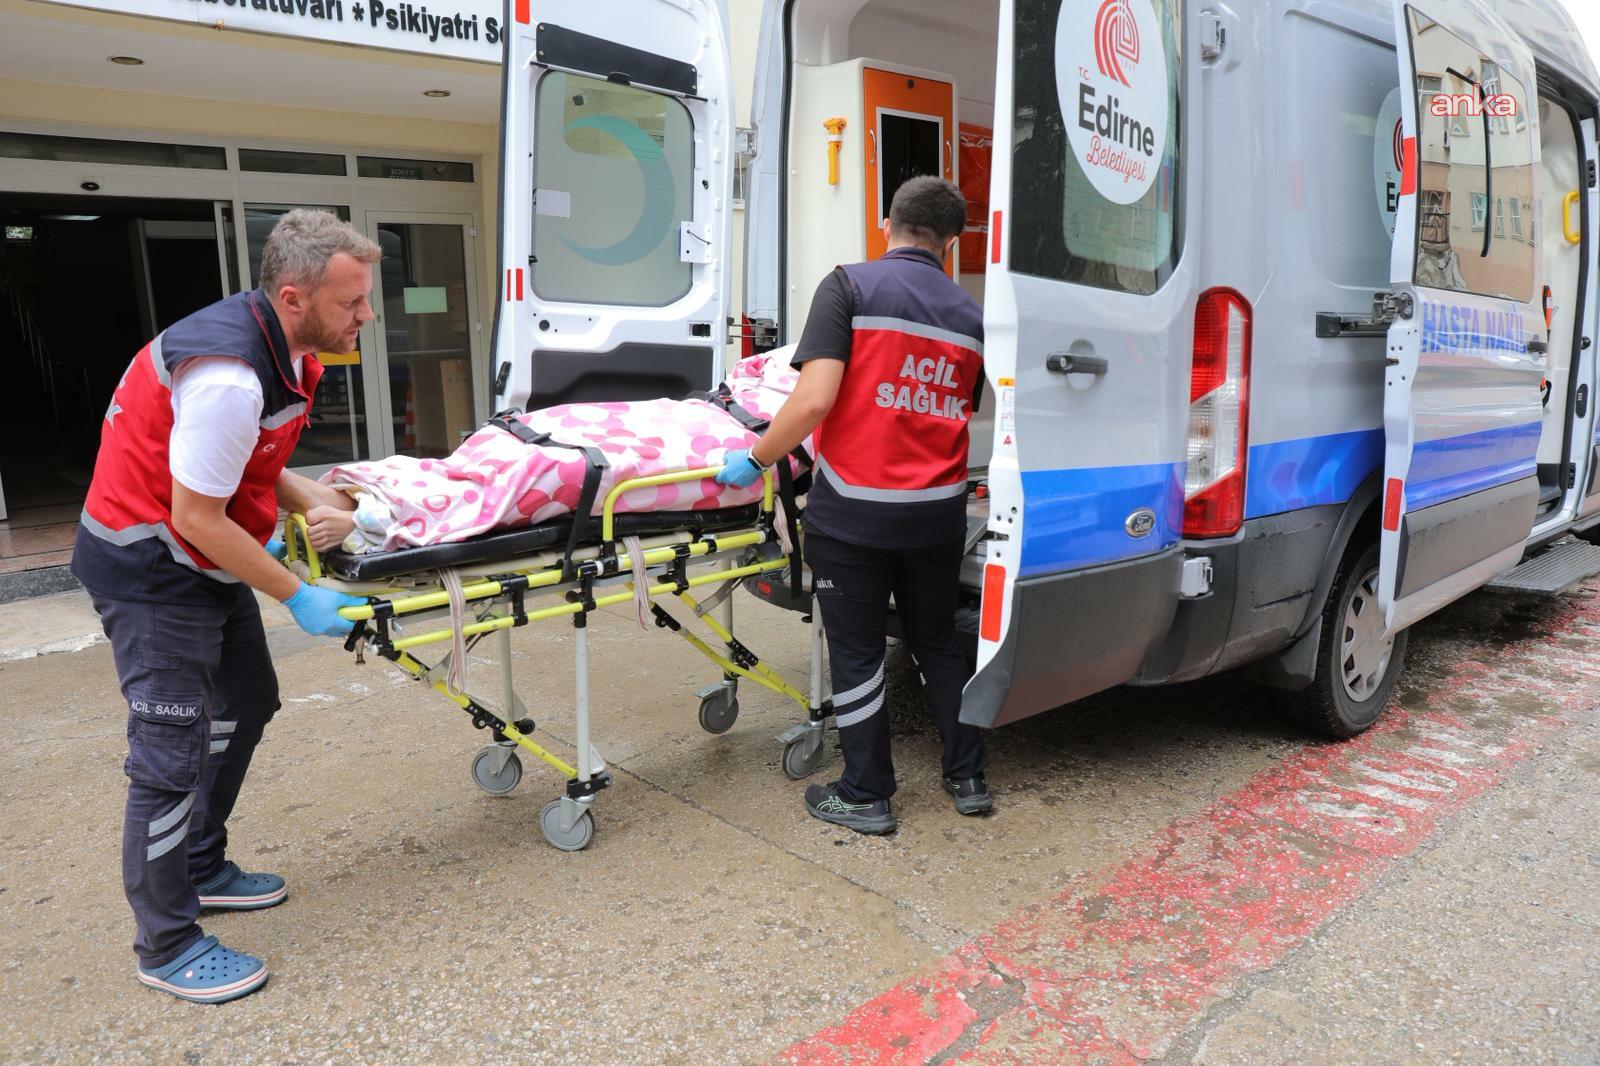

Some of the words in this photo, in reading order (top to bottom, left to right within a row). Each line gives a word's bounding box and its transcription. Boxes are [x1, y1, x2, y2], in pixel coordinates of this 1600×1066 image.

[369, 0, 479, 42] Psikiyatri
[1078, 81, 1155, 157] Edirne
[1086, 135, 1147, 183] Belediyesi
[1421, 302, 1480, 354] HASTA
[899, 354, 959, 389] ACİL
[875, 382, 969, 421] SAĞLIK
[130, 700, 151, 714] ACİL
[155, 704, 197, 717] SAĞLIK
